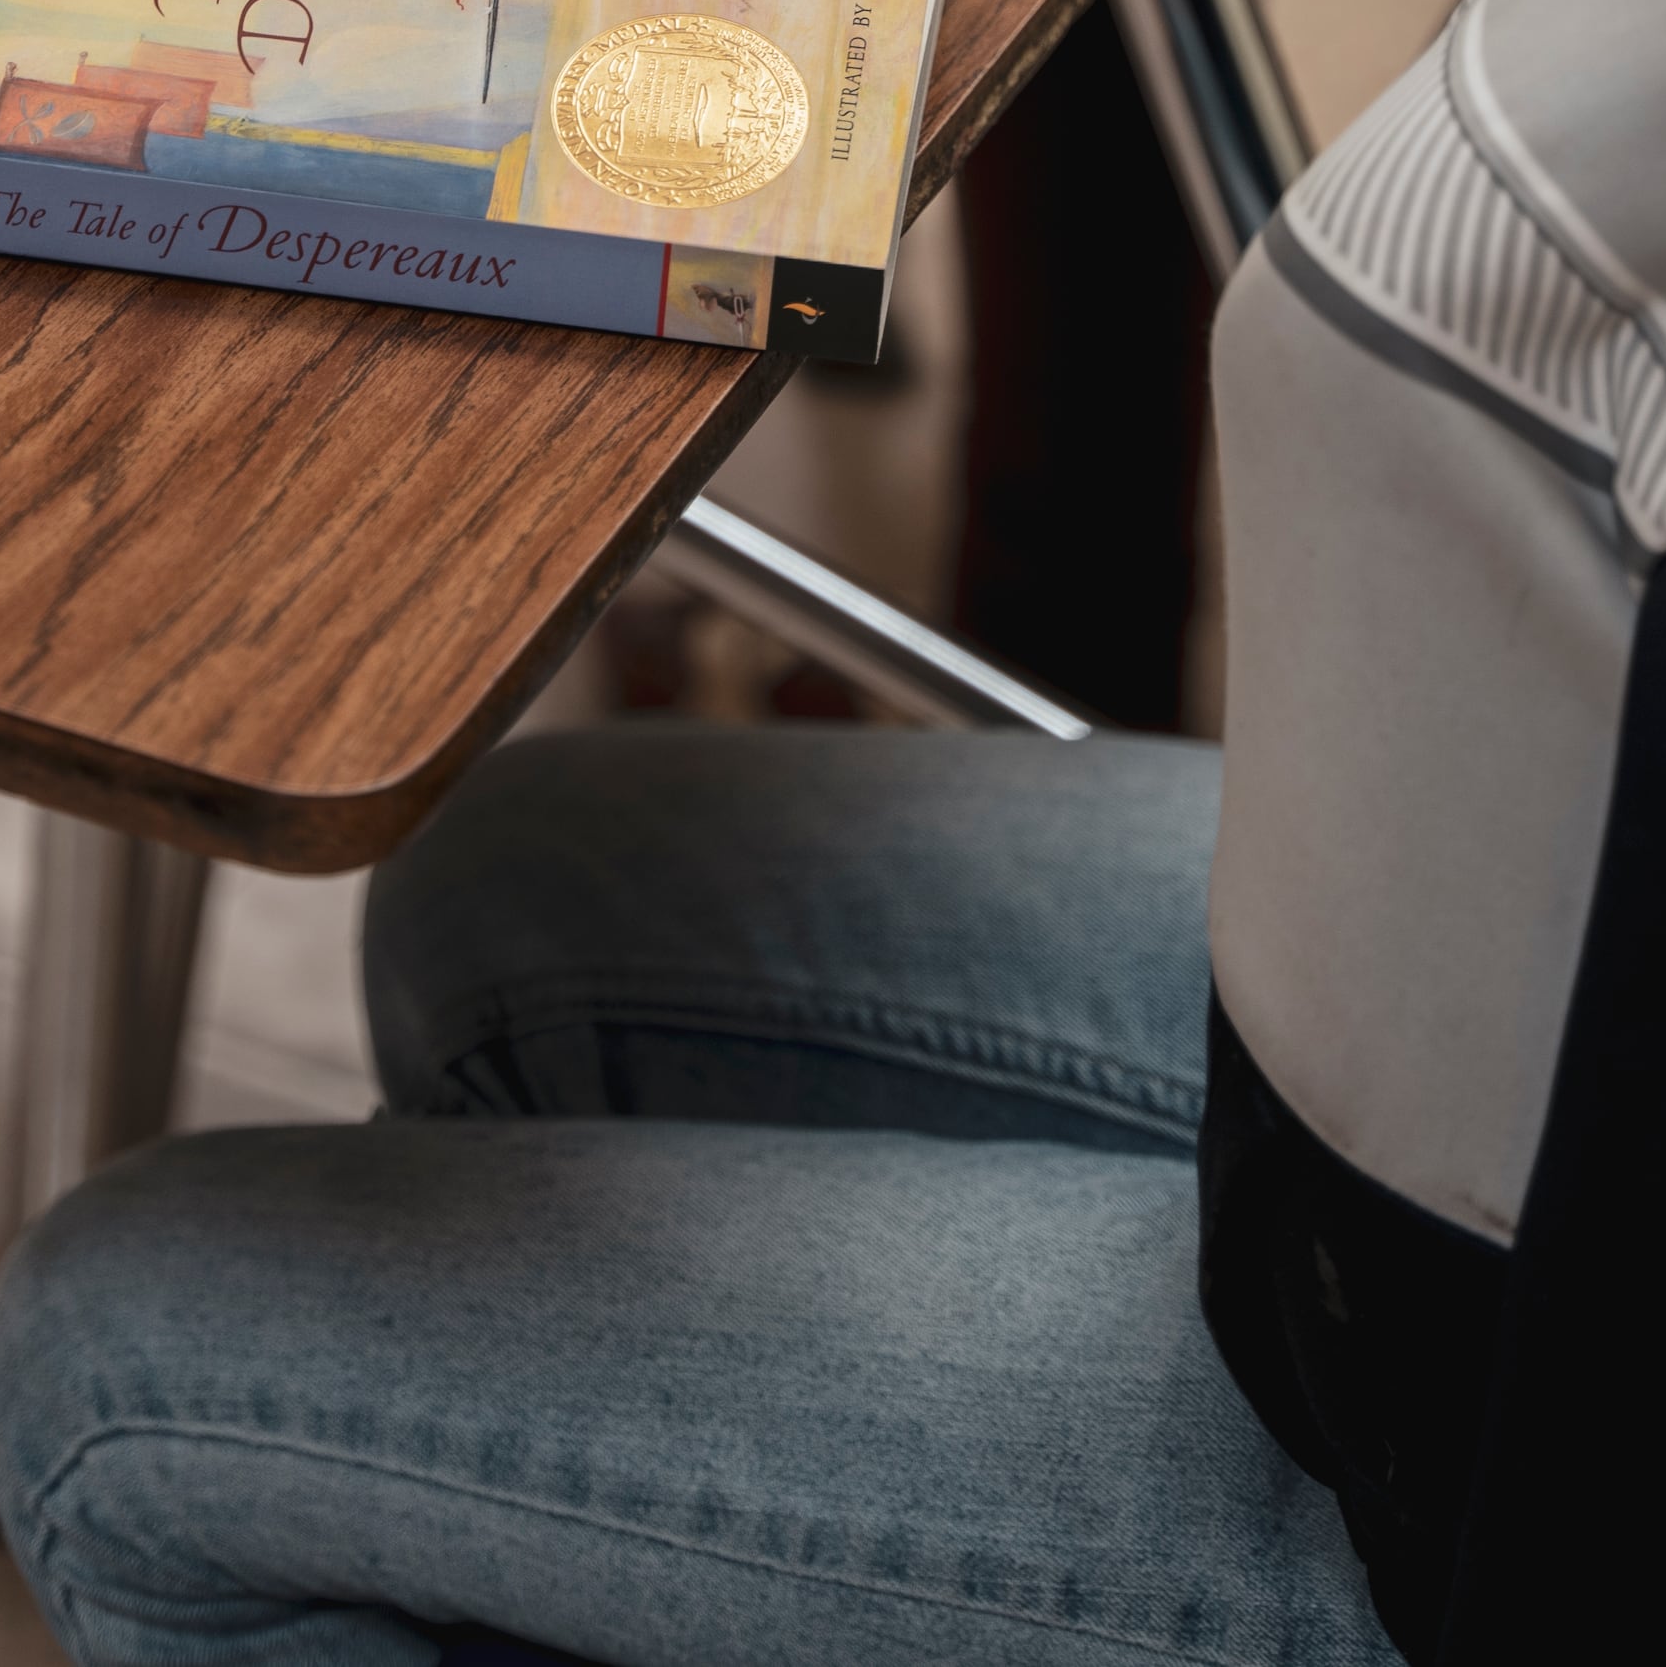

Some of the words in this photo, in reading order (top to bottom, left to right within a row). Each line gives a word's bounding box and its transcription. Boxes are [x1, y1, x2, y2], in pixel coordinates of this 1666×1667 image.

[588, 16, 689, 56] MEDAL
[830, 36, 868, 162] ILLUSTRATED
[852, 3, 873, 28] BY
[65, 198, 136, 242] Tale
[147, 211, 197, 261] of
[196, 202, 518, 291] Despereaux
